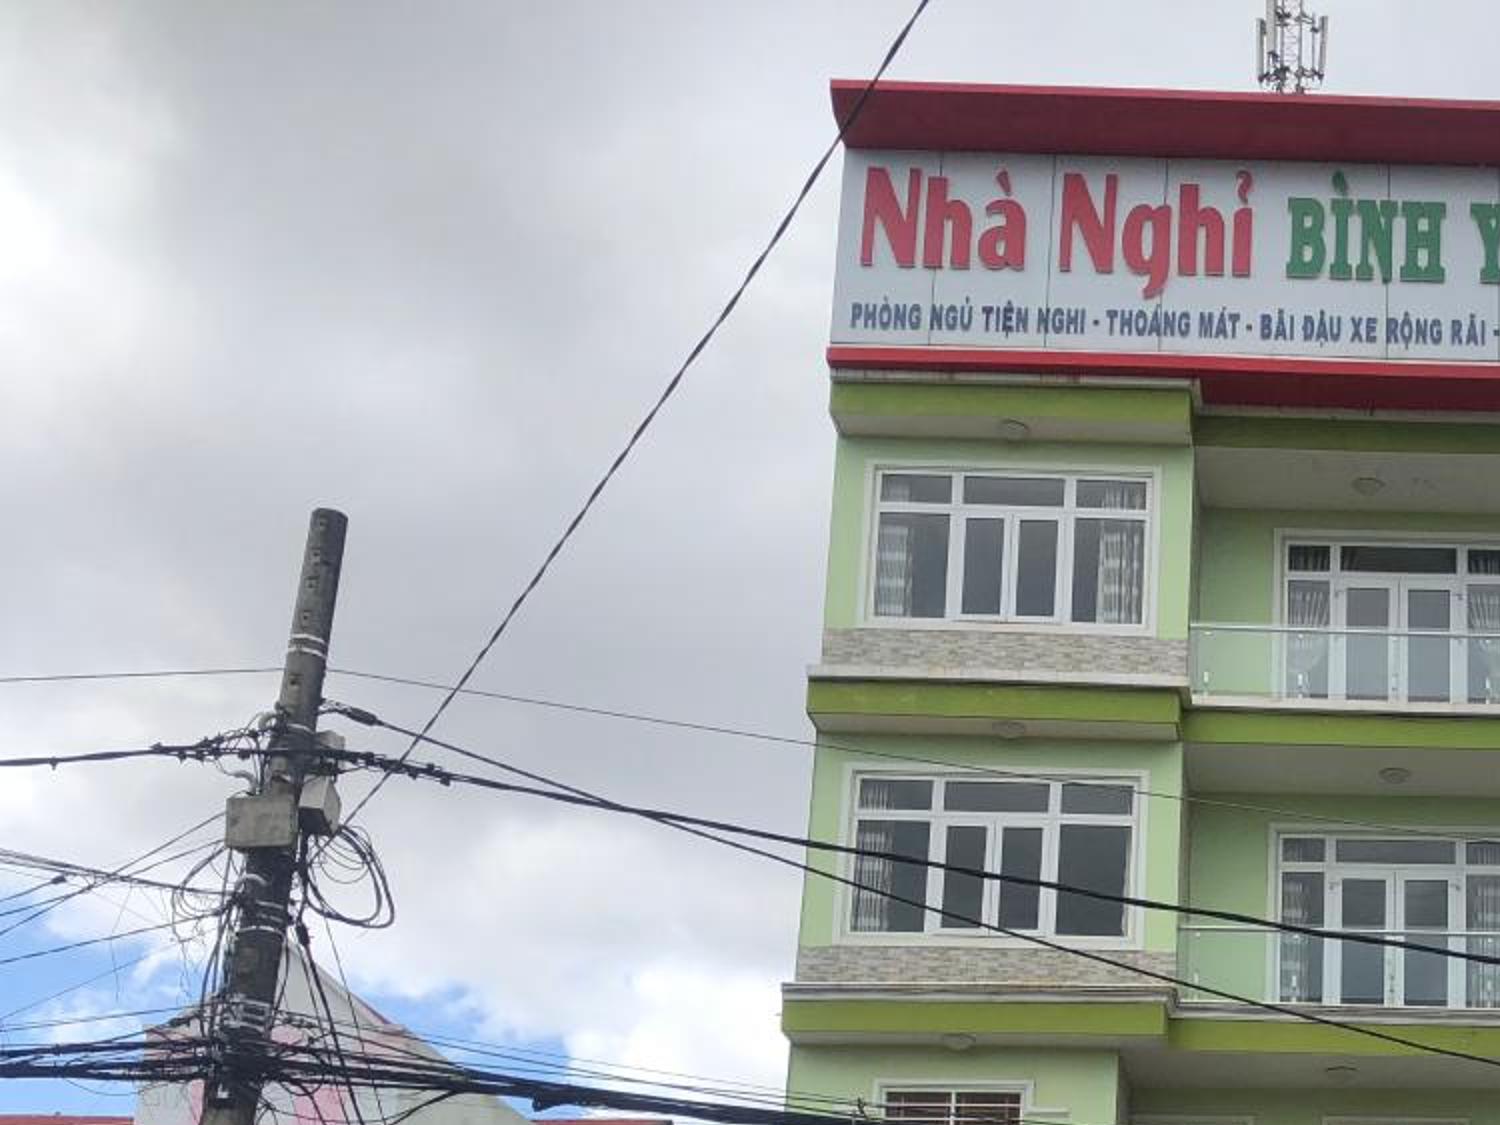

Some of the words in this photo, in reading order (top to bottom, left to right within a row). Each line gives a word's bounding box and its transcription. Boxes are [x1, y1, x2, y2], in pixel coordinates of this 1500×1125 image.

[860, 165, 1027, 271] Nhà
[1059, 170, 1254, 299] Nghỉ
[1285, 169, 1447, 285] BÌNH
[850, 298, 922, 331] PHÒNG
[981, 300, 1029, 338] TIỆN
[1036, 307, 1086, 335] NGHI
[1105, 303, 1191, 338] THOÁNG
[1199, 304, 1241, 340] MÁT
[1302, 309, 1342, 348] ĐẬU
[1350, 316, 1378, 343] XE
[1385, 311, 1443, 349] RỘNG
